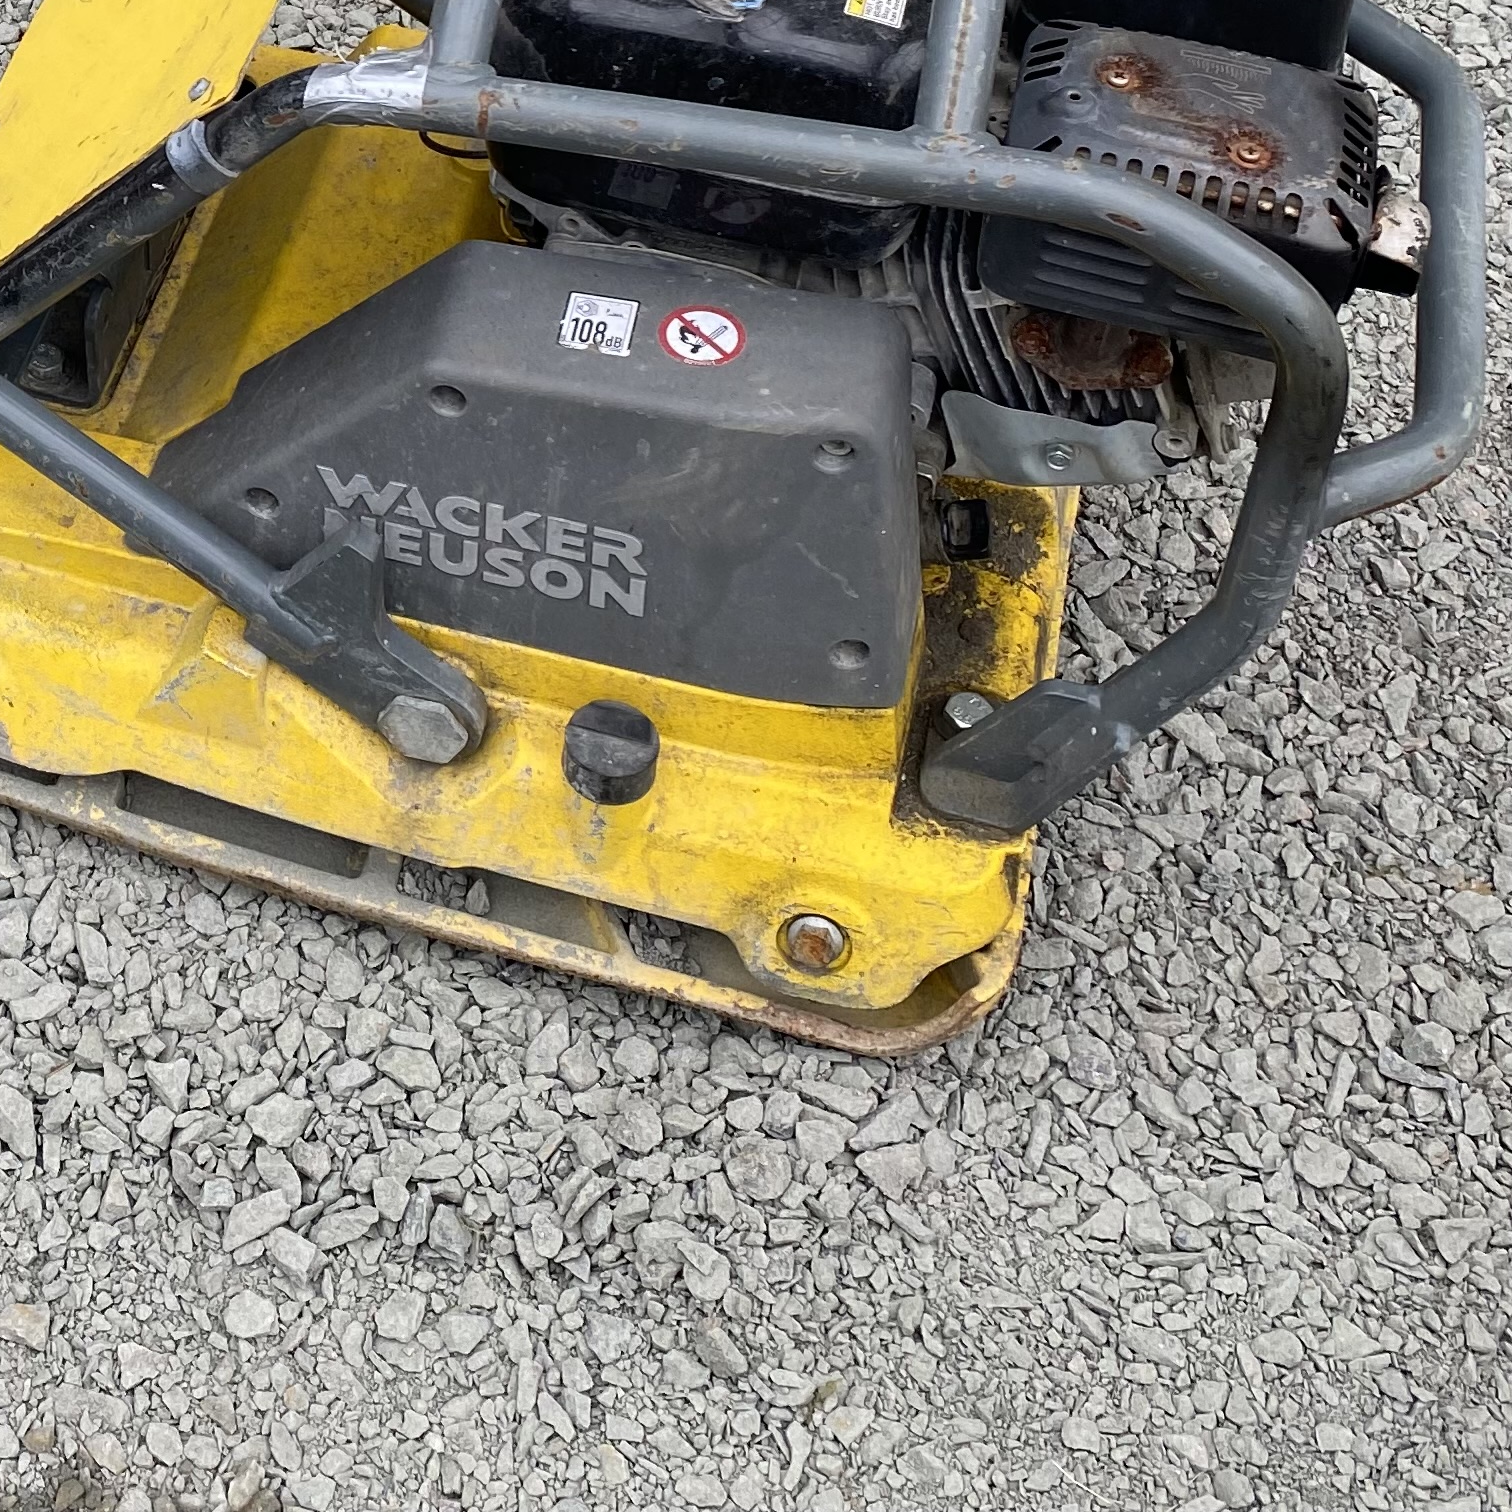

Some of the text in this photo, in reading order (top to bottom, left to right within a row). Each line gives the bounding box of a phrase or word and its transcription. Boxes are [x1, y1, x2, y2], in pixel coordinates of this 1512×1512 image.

[570, 317, 623, 348] 108 dB
[315, 464, 648, 577] WACKER
